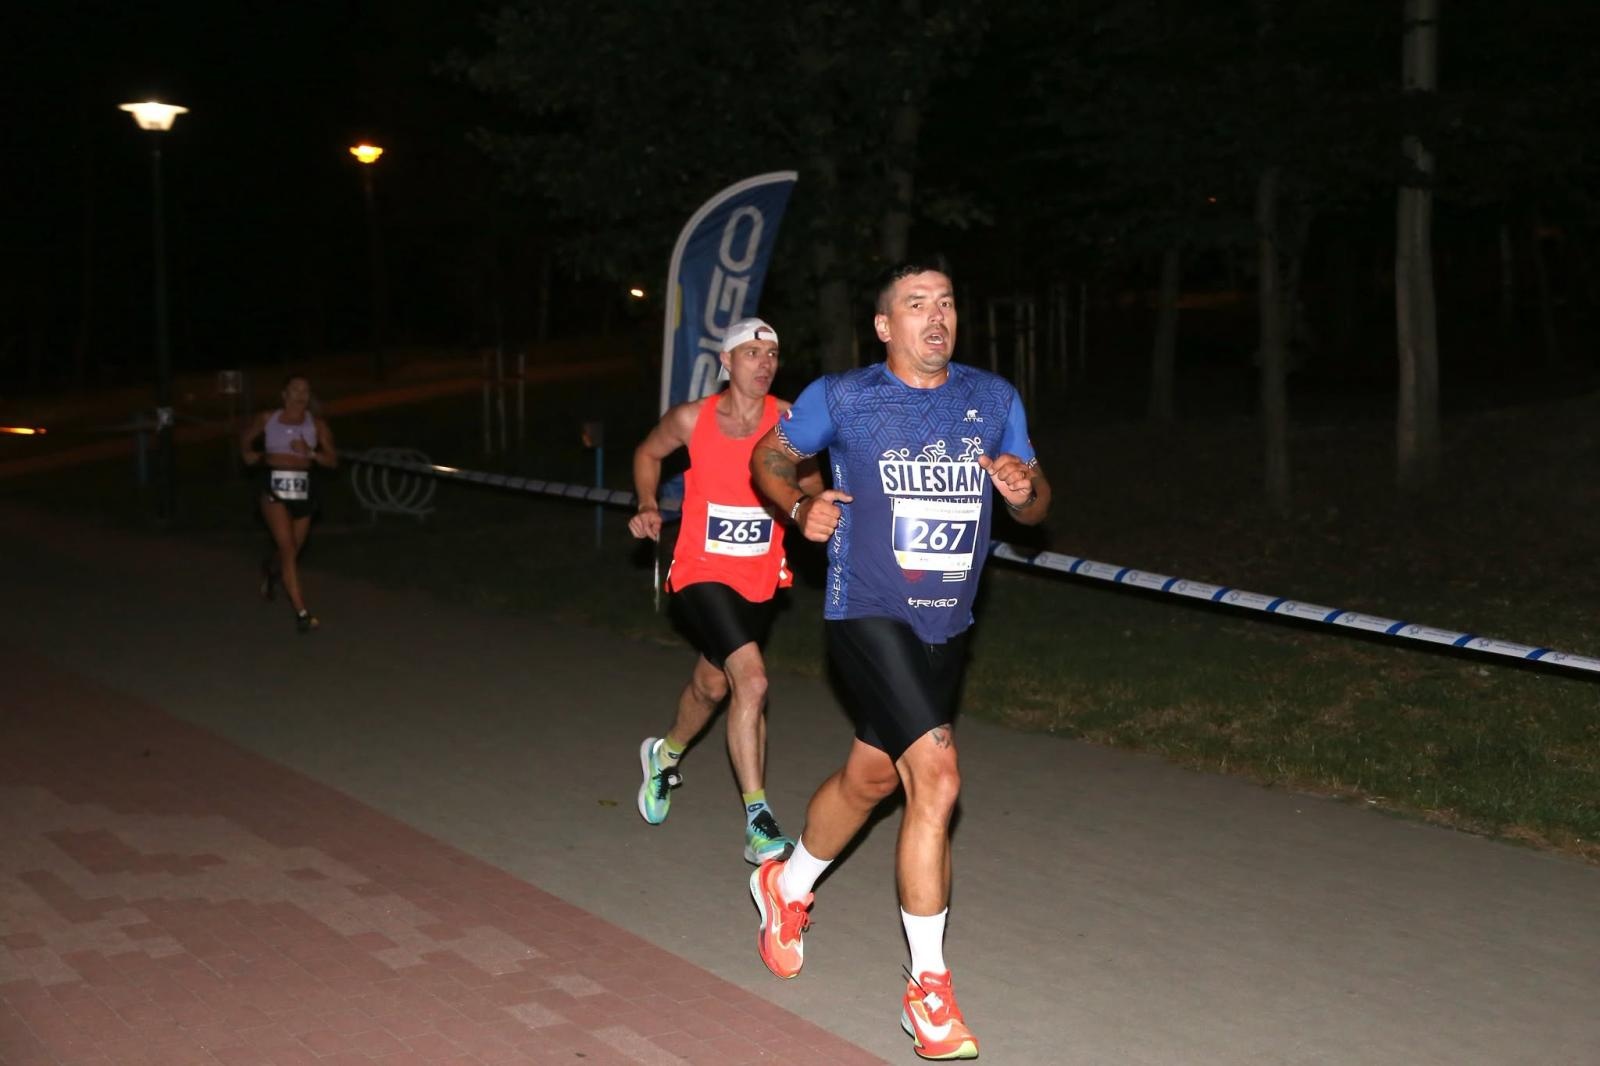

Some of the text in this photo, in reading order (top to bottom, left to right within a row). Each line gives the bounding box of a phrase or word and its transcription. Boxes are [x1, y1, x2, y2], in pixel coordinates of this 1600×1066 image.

[883, 463, 982, 492] SILESIAN
[718, 519, 763, 543] 265
[908, 521, 968, 552] 267
